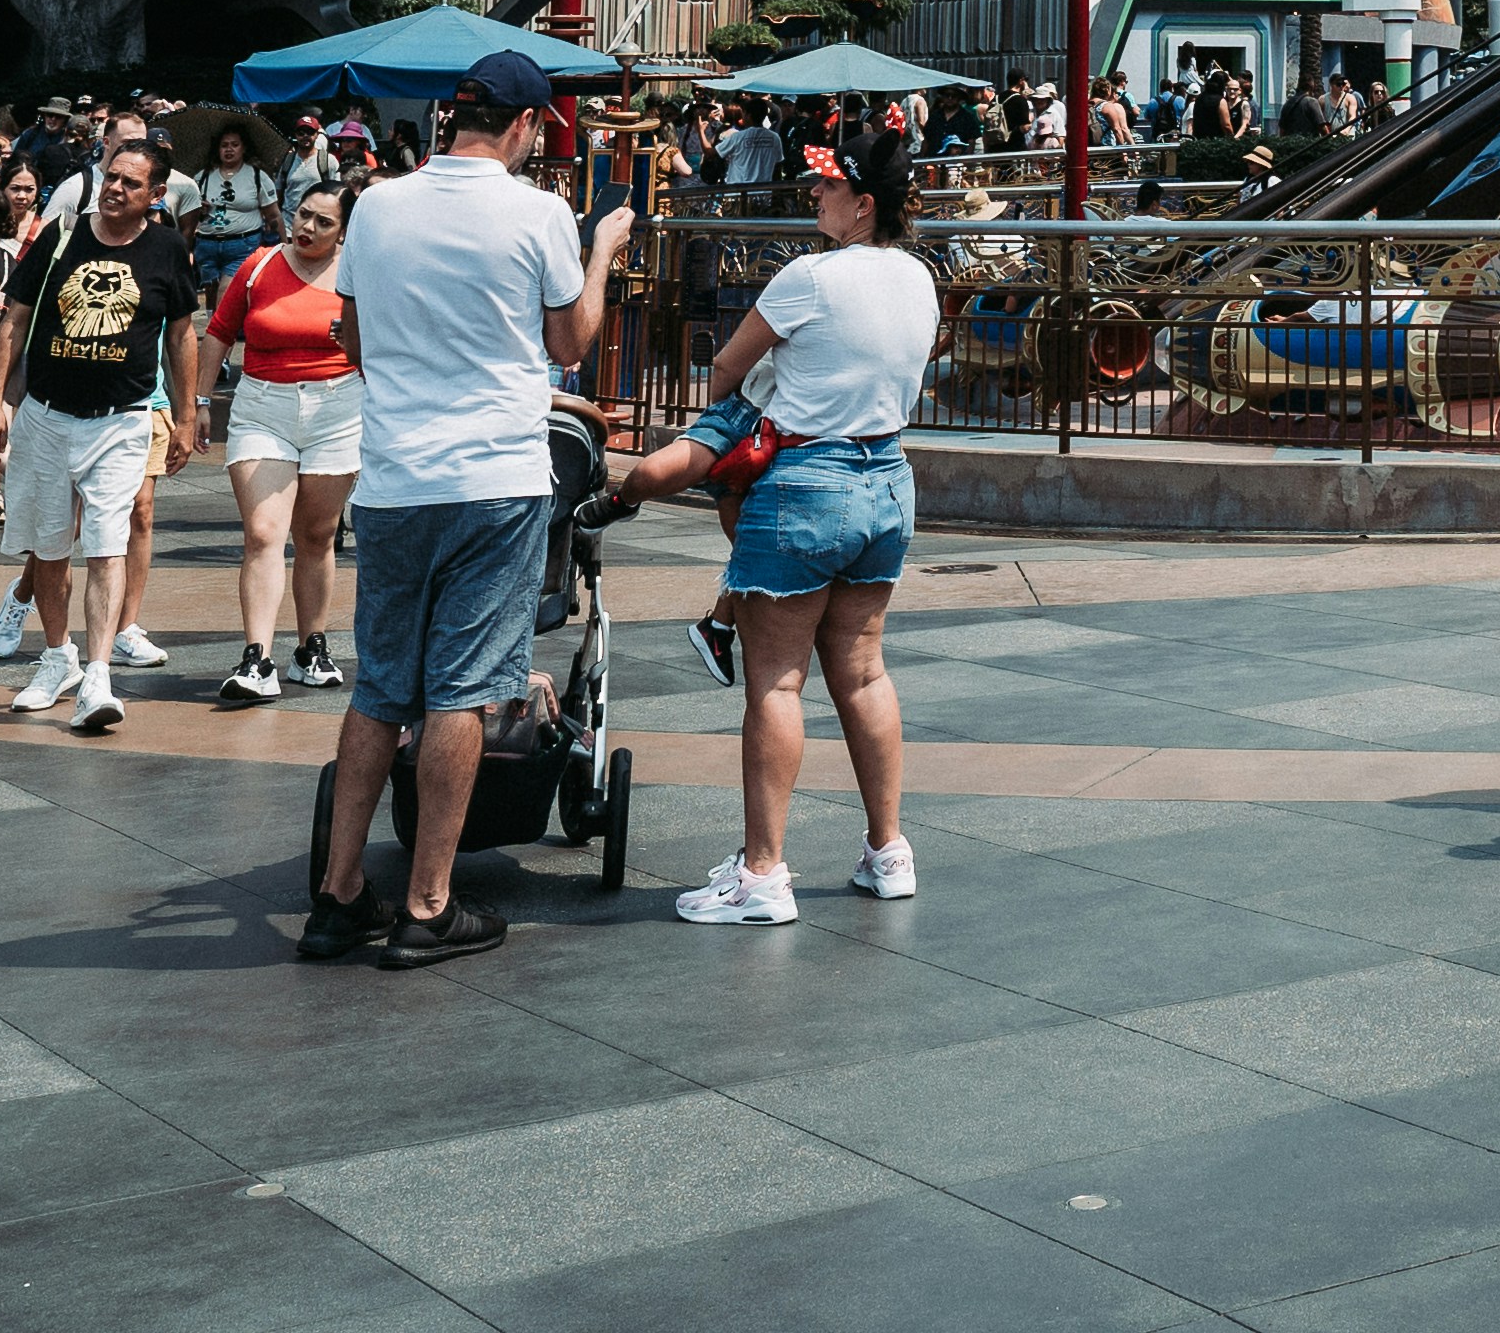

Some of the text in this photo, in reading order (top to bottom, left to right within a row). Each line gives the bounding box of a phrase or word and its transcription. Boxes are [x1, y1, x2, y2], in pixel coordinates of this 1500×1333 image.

[51, 339, 127, 361] EL REY LEÓN
[890, 859, 906, 869] AIR
